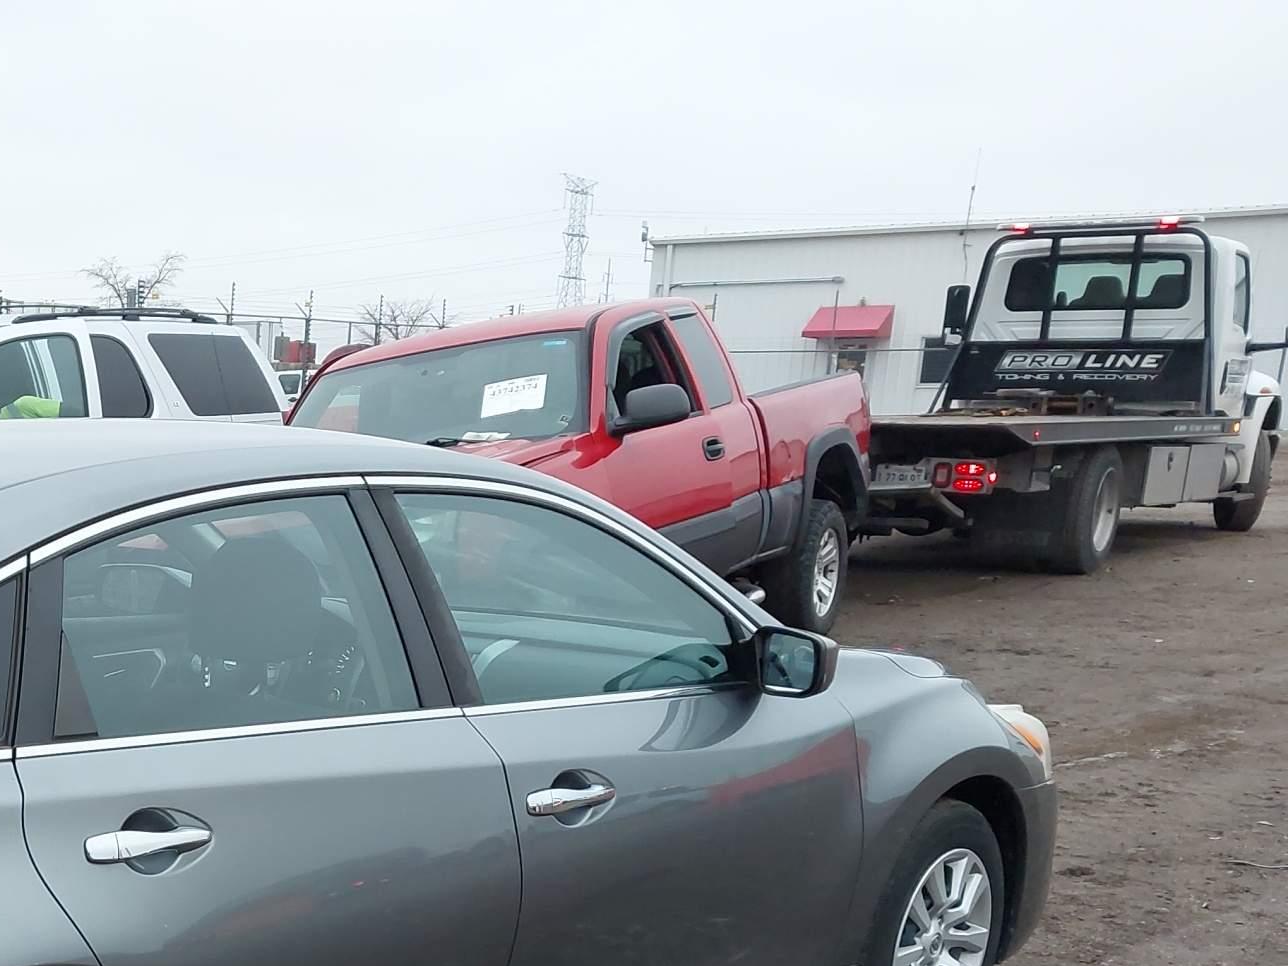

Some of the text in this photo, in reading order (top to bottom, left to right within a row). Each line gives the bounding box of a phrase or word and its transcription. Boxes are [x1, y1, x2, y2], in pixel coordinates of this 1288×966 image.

[1007, 354, 1165, 368] PRO LINE
[1072, 373, 1160, 381] RECOVERY
